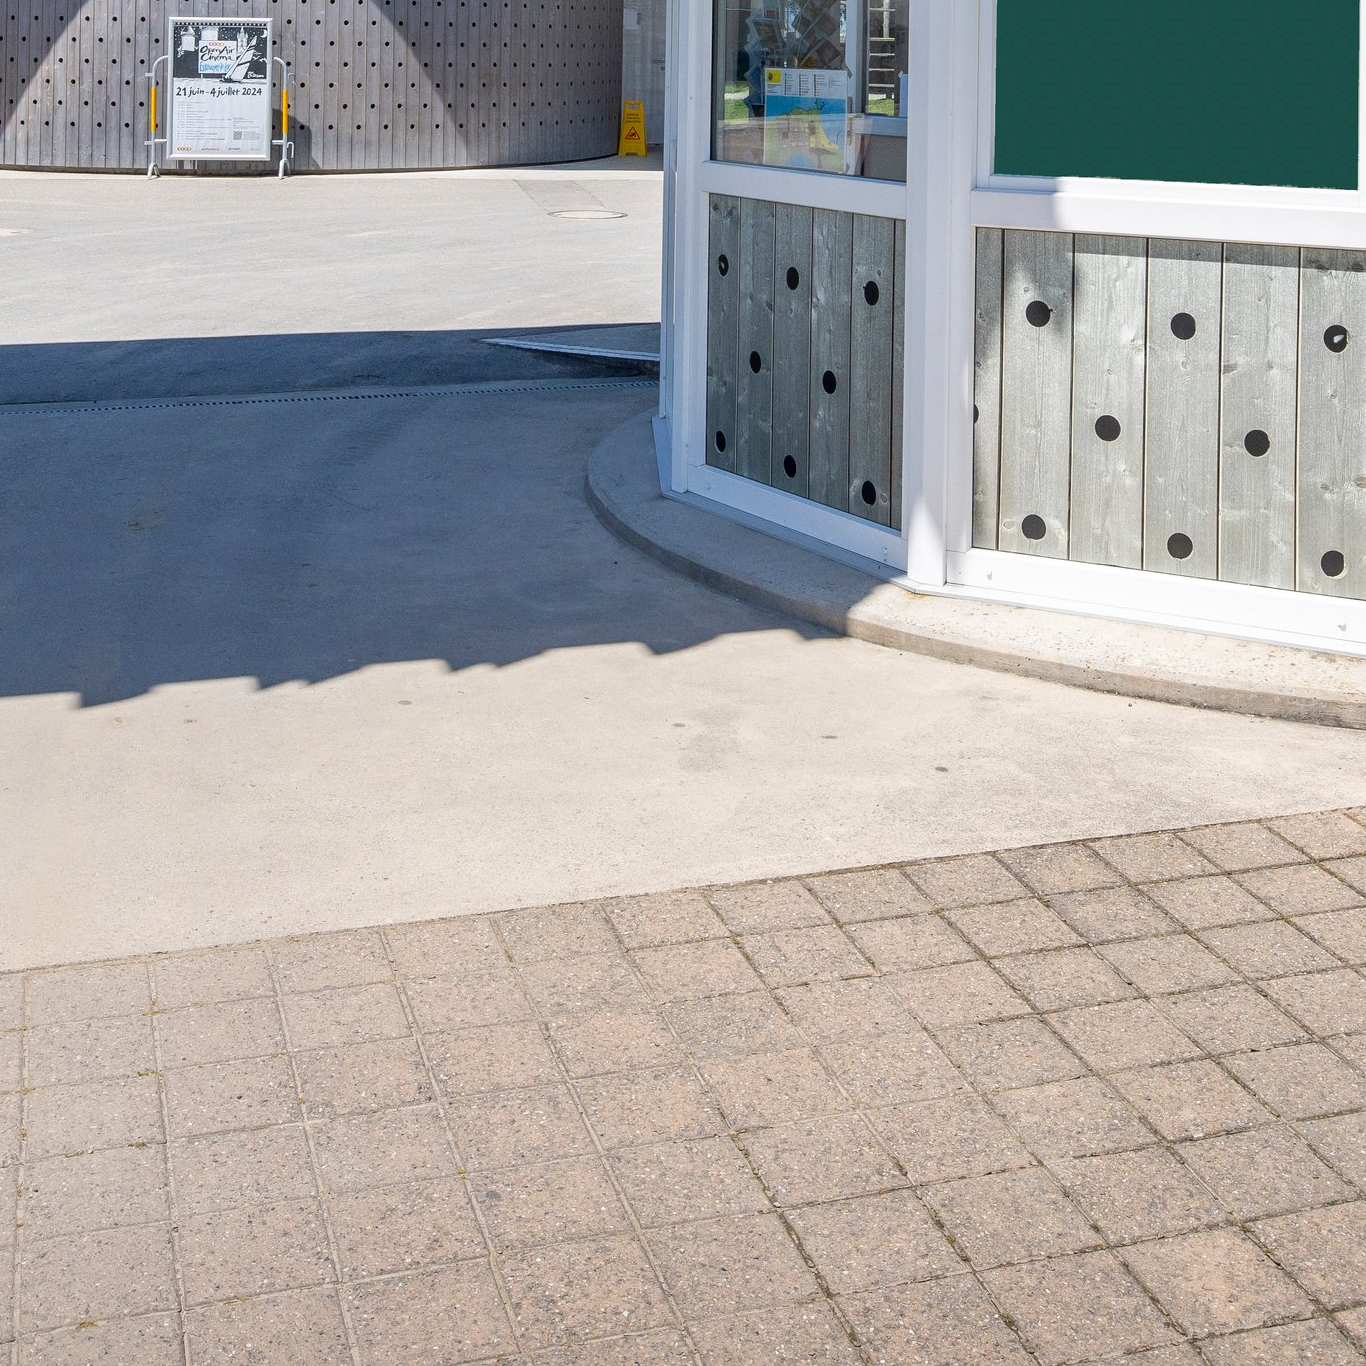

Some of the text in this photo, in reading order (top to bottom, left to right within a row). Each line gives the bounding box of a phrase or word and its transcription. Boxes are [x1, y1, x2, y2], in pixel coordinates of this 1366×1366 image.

[200, 52, 235, 62] Cinema
[176, 87, 186, 96] 21
[188, 87, 204, 97] juin
[210, 87, 216, 97] 4
[217, 86, 240, 98] juillet
[241, 87, 262, 96] 2024
